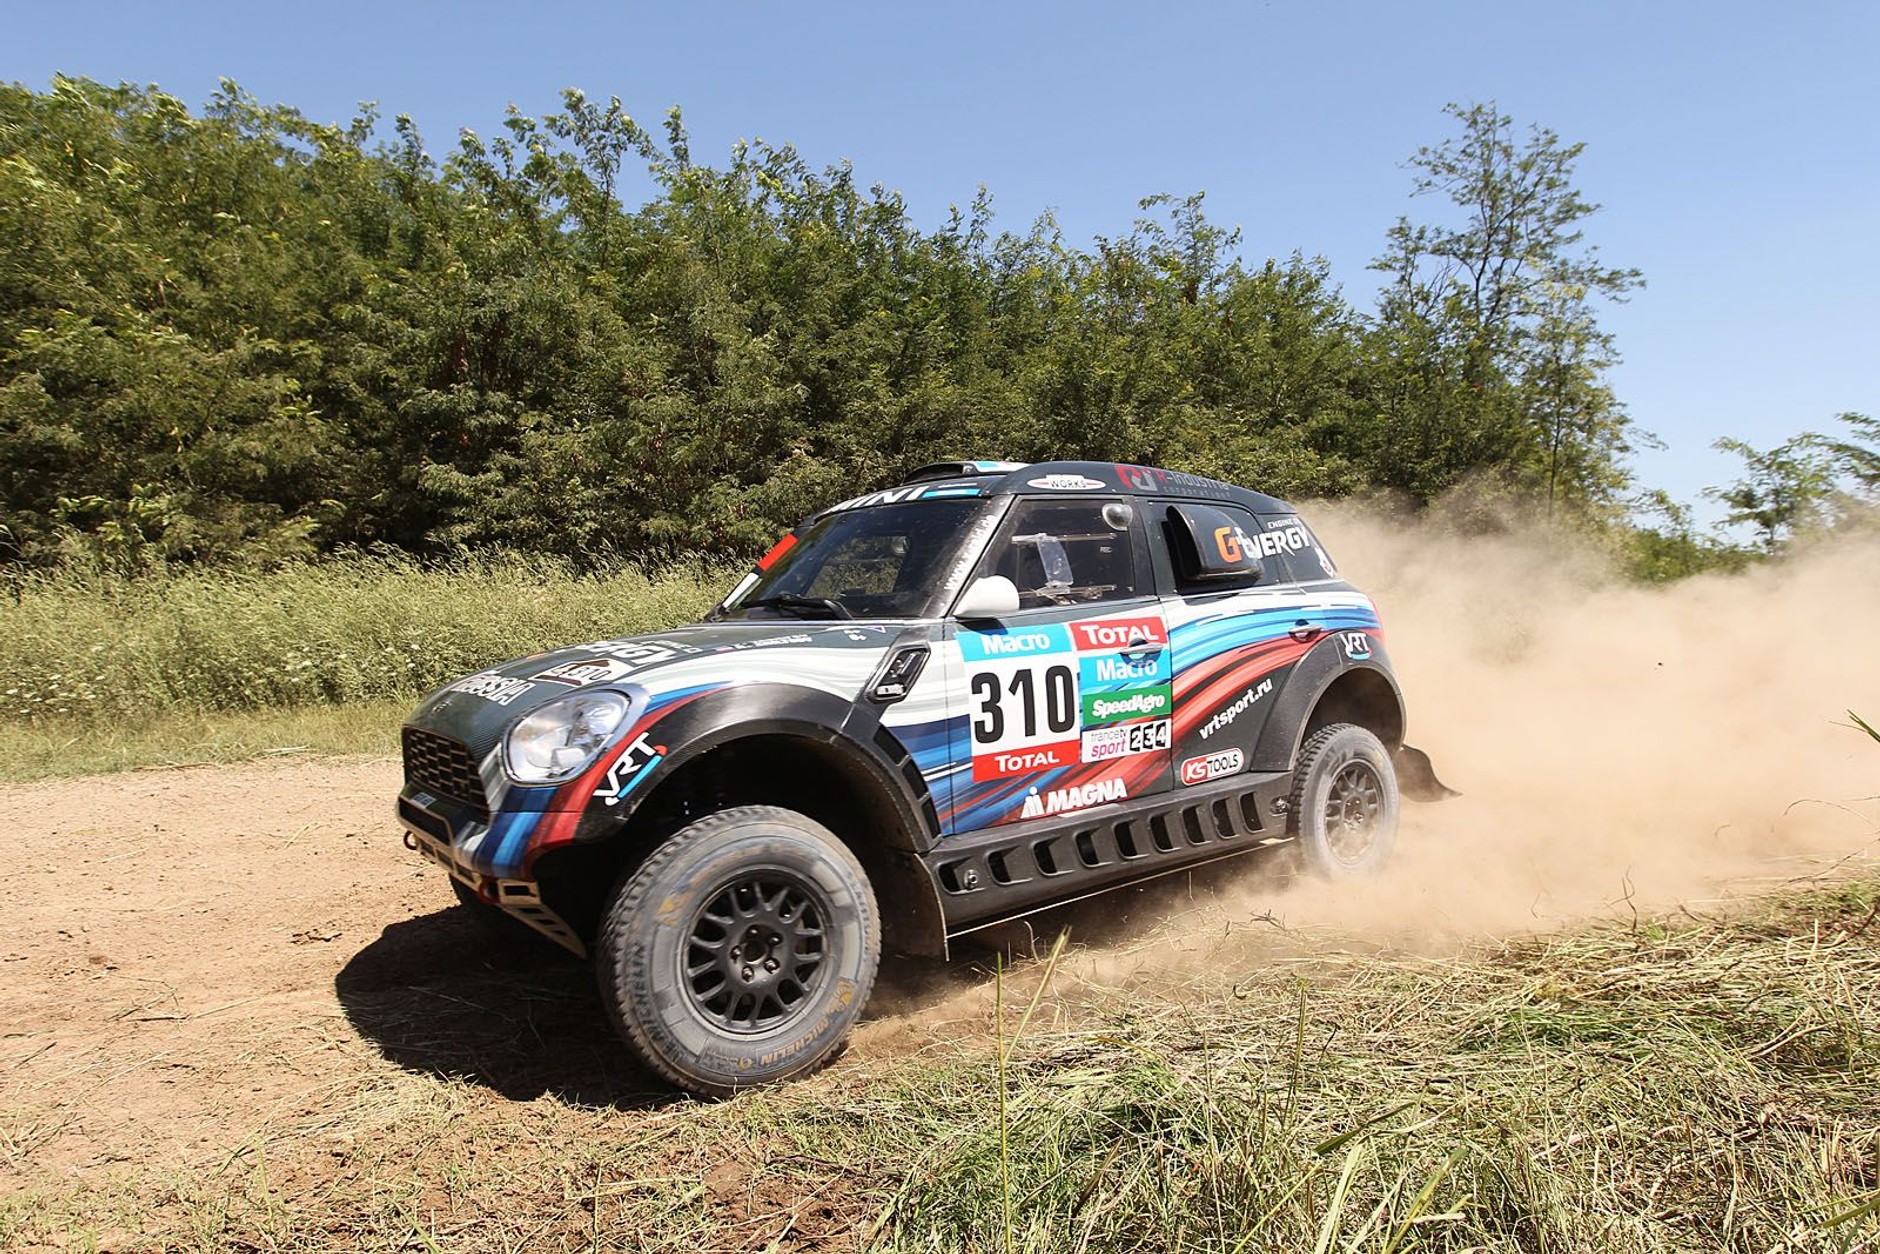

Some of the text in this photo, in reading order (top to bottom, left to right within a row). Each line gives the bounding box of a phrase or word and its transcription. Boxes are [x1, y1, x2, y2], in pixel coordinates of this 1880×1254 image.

[1050, 479, 1086, 488] WORKS
[981, 633, 1051, 655] Macro
[1080, 624, 1160, 646] TOTAL
[1340, 632, 1370, 657] VRT
[1097, 659, 1158, 682] Macro
[452, 670, 536, 706] SSIA
[971, 665, 1076, 744] 310
[1092, 694, 1165, 719] SpeedAgro
[1199, 679, 1273, 740] vrtsport.ru
[1091, 739, 1127, 759] sport
[593, 731, 657, 803] VRT
[994, 751, 1060, 773] TOTAL
[1046, 778, 1128, 812] MAGNA
[760, 1018, 830, 1065] MICHELIN
